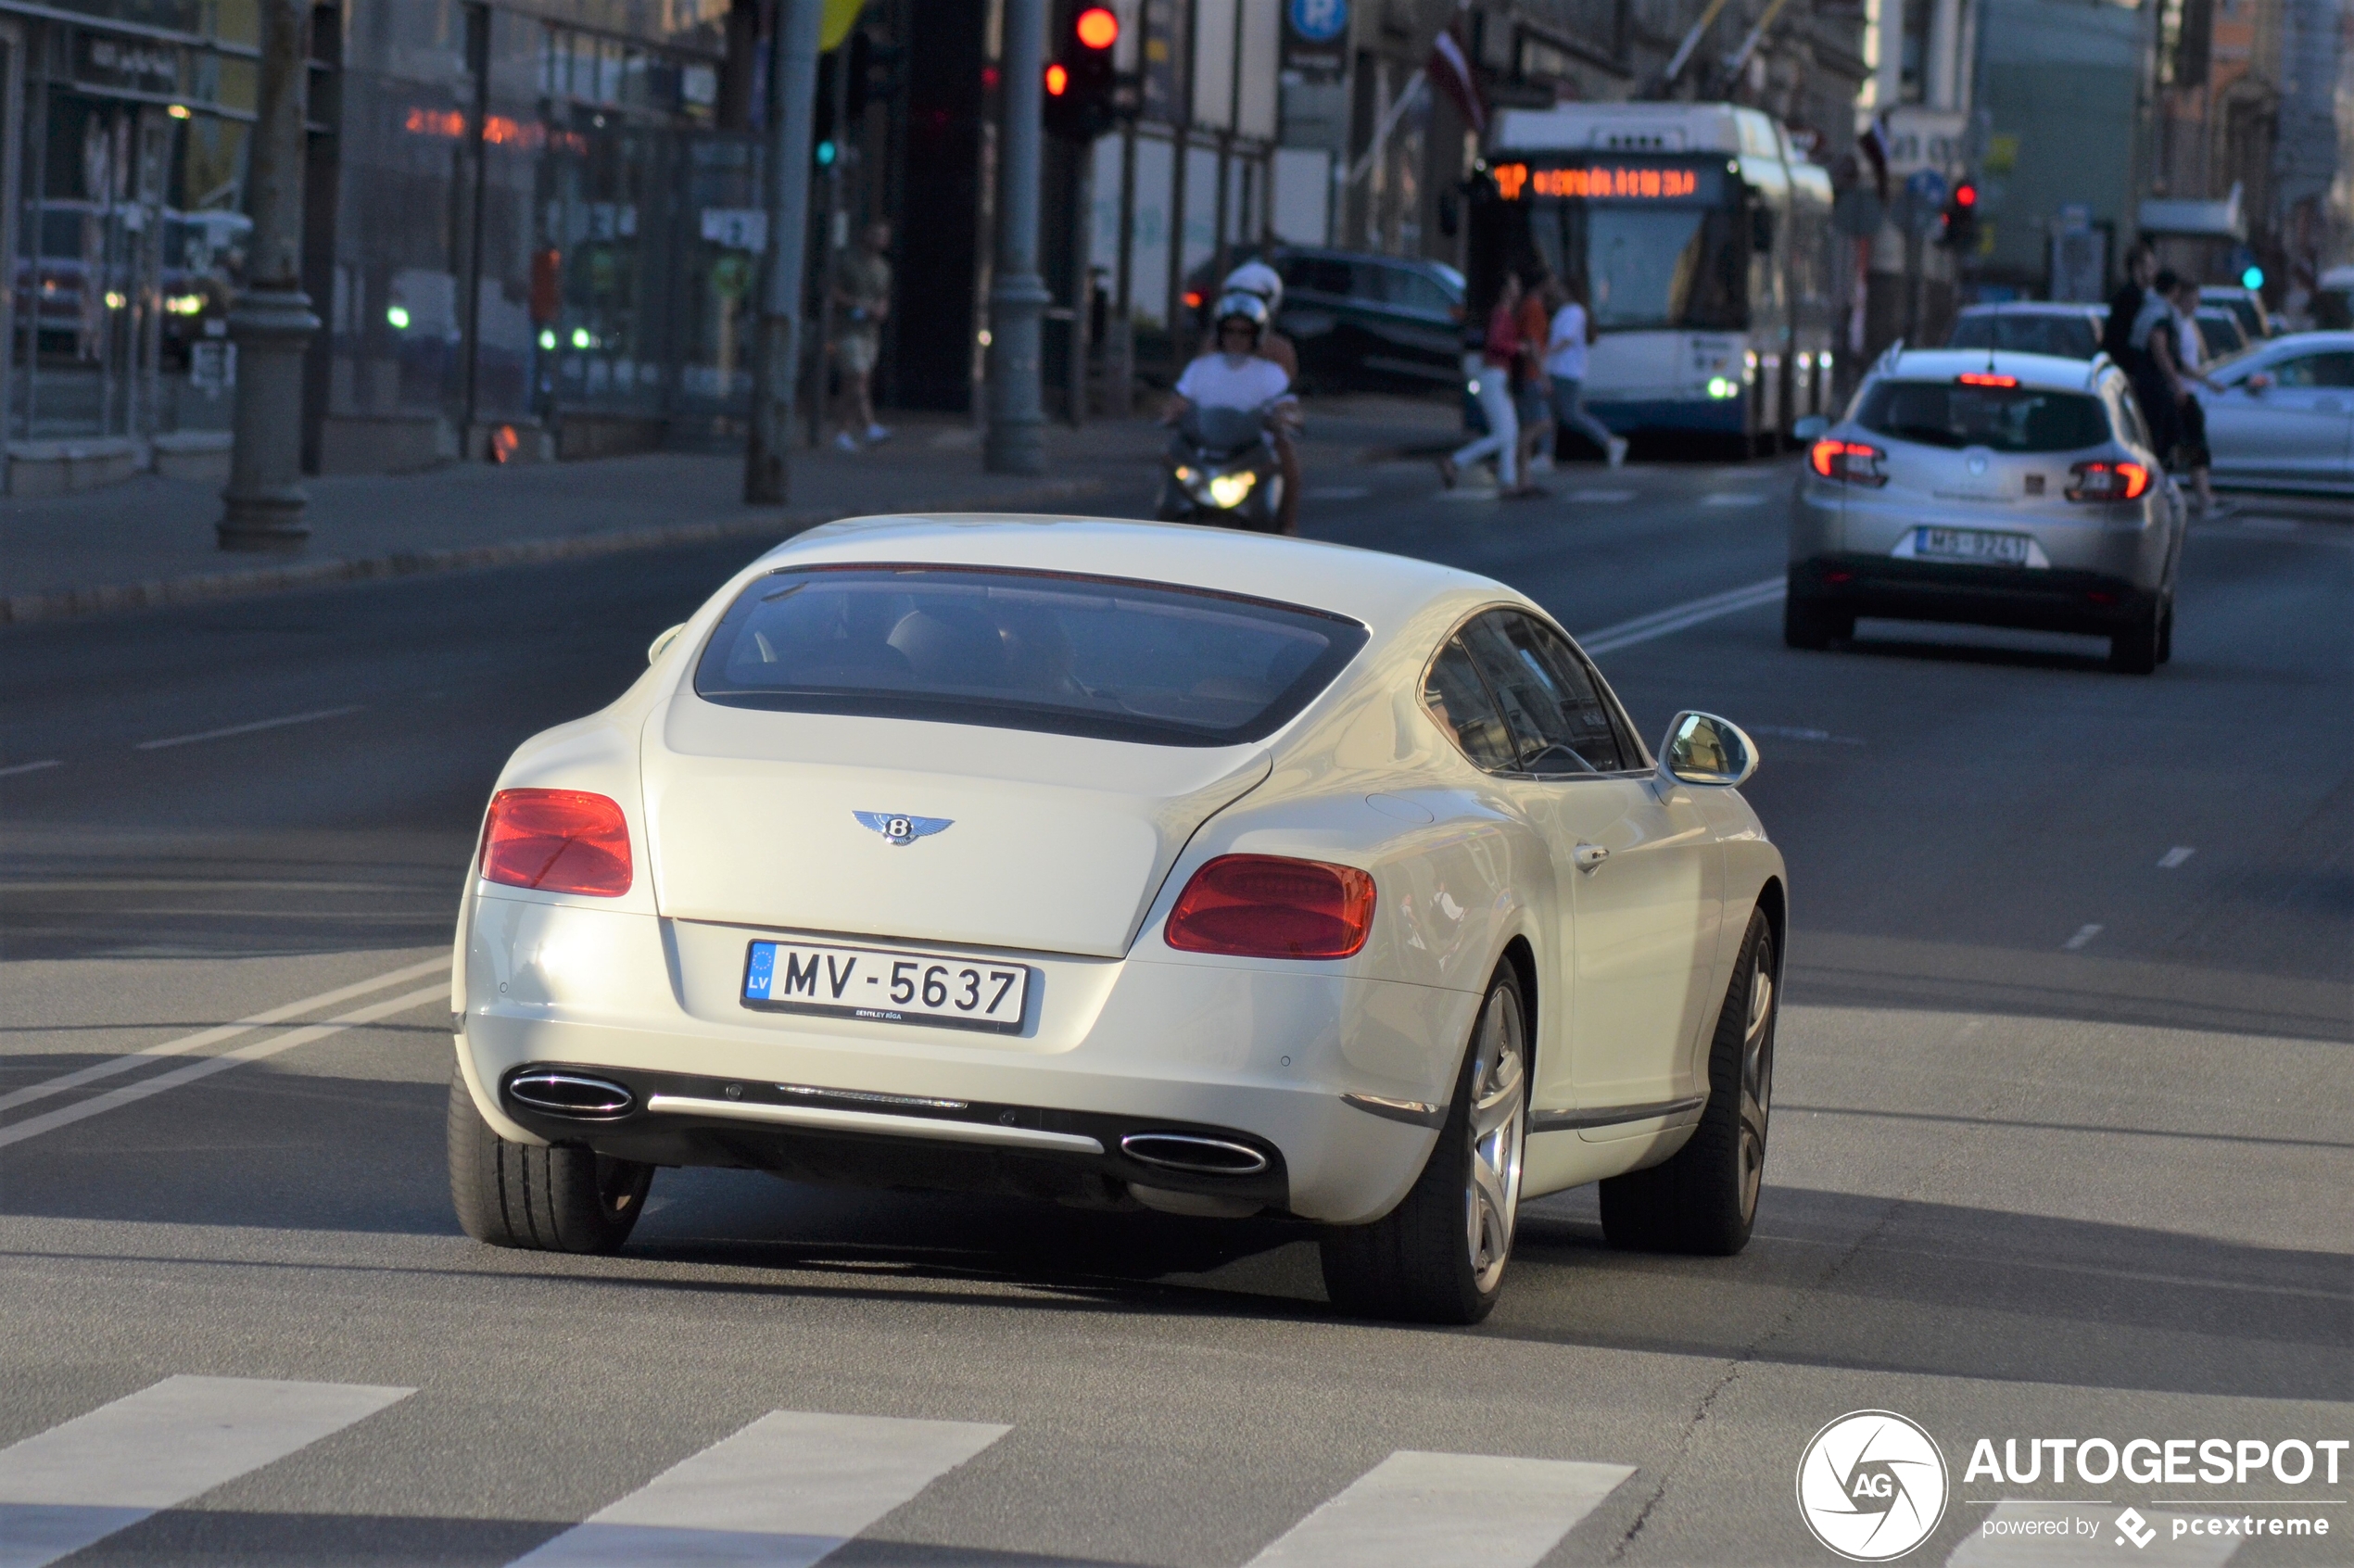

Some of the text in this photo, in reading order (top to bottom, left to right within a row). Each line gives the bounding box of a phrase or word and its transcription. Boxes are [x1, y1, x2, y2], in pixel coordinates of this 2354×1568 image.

[889, 818, 909, 837] B
[749, 976, 768, 990] LV
[855, 1009, 885, 1018] BENTLEY
